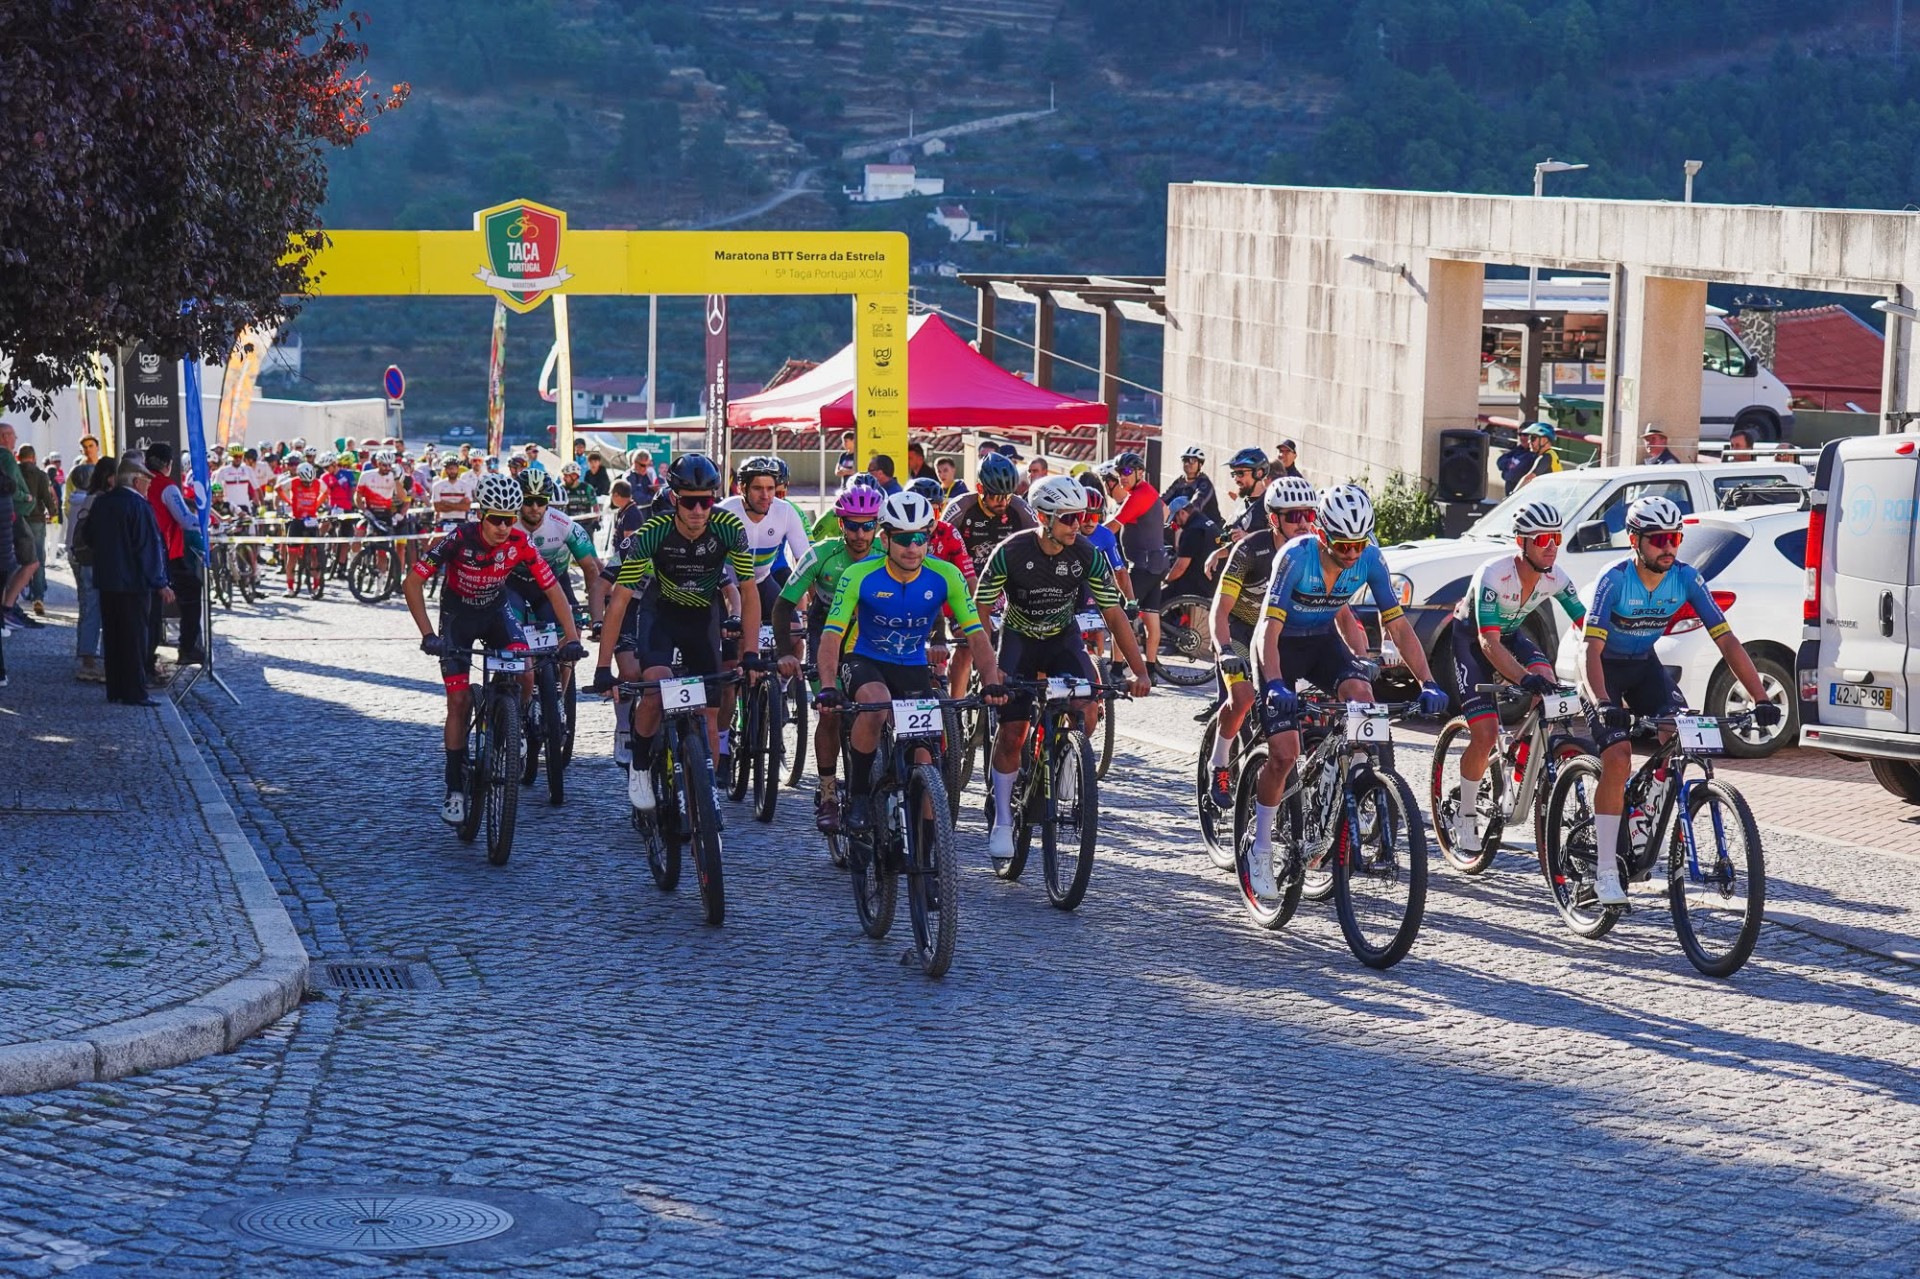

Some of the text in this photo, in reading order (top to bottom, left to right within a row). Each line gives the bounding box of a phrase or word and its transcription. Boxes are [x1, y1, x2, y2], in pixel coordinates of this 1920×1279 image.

[507, 242, 540, 263] TAÇA
[714, 250, 885, 261] Maratona BTT Serra da Estrela
[507, 262, 541, 273] PORTUGAL
[789, 269, 812, 281] Taça
[814, 269, 857, 281] Portugal
[858, 269, 883, 279] XCM
[868, 387, 899, 397] Vitalis
[134, 392, 169, 406] Vitalis
[828, 576, 852, 617] seia
[872, 612, 928, 628] seia
[534, 635, 549, 646] 17
[498, 662, 517, 670] 13
[680, 689, 691, 704] 3
[1559, 701, 1568, 714] 8
[908, 713, 931, 730] 22
[1363, 722, 1374, 737] 6
[1695, 732, 1703, 745] 1
